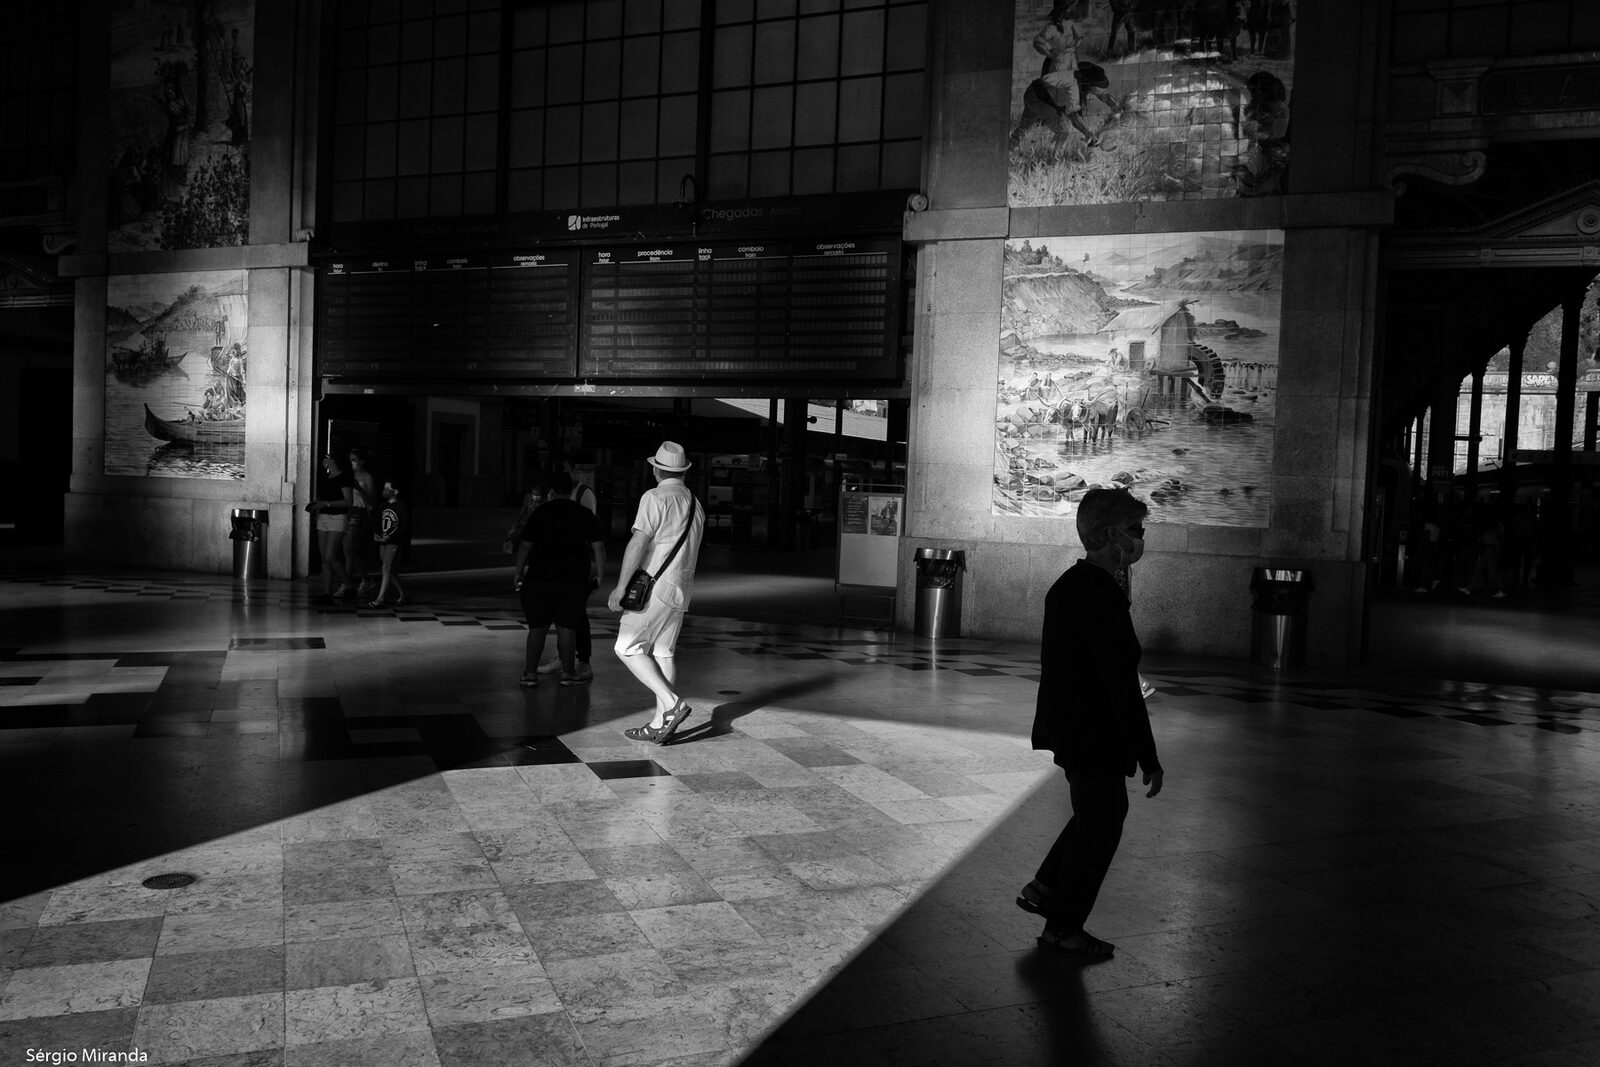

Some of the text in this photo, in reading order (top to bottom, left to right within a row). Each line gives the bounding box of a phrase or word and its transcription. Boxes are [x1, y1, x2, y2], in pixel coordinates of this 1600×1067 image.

[702, 206, 764, 221] Chegadas
[582, 215, 620, 223] Infraestruturas
[737, 245, 764, 253] comboio
[816, 242, 856, 250] observações
[637, 249, 673, 258] procedência
